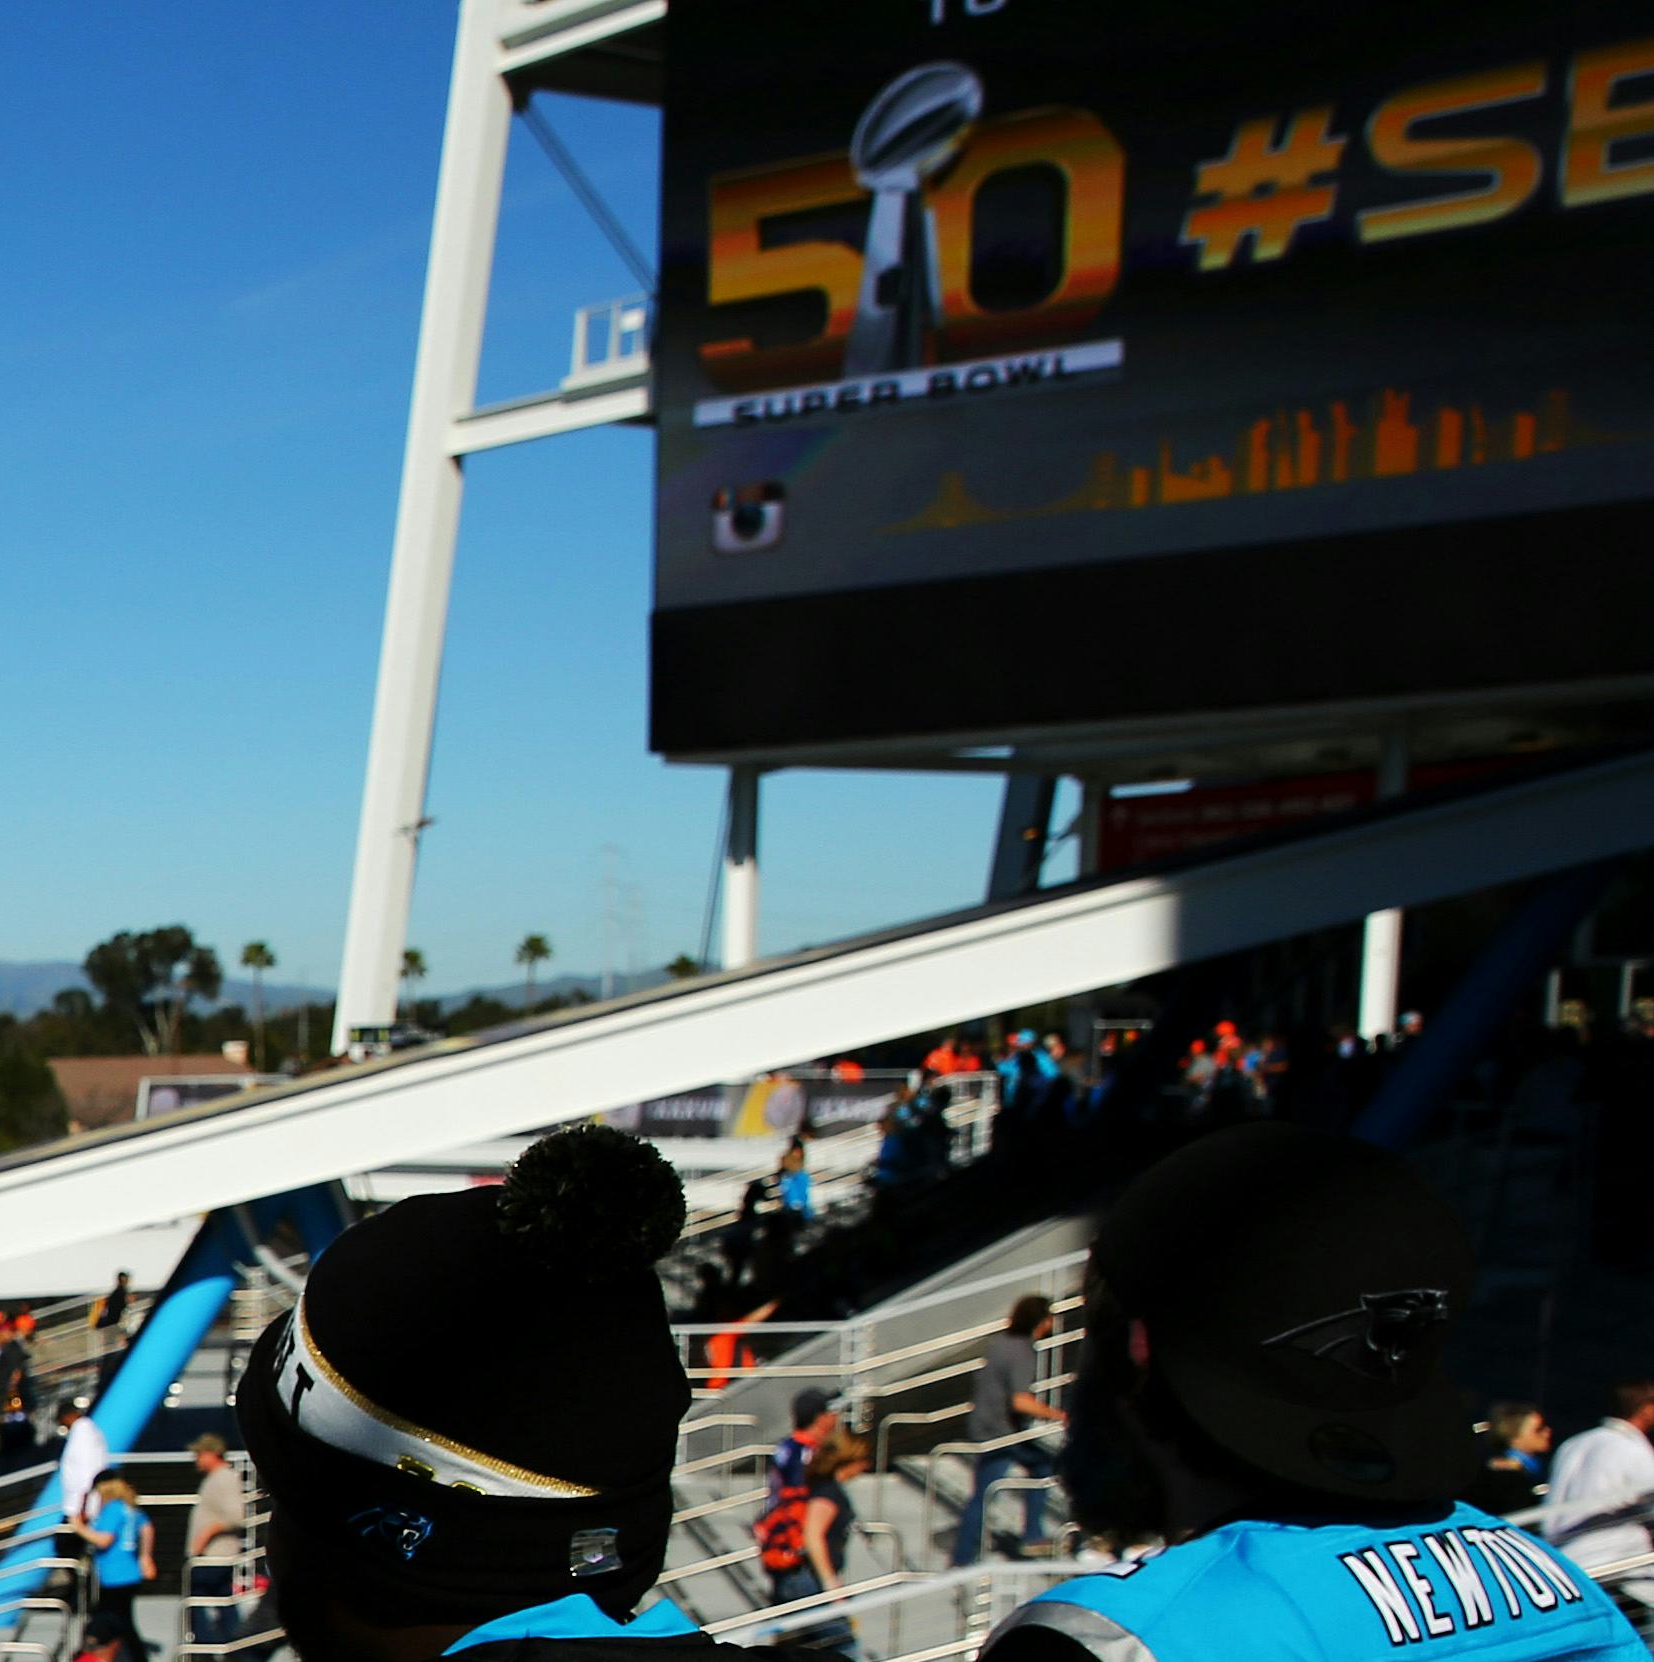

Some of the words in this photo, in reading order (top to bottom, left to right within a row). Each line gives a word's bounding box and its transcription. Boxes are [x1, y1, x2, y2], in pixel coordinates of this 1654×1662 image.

[700, 106, 1125, 390] 50
[733, 380, 901, 426] SUPER
[926, 353, 1079, 397] BOWL
[1336, 1525, 1584, 1646] NEWTON
